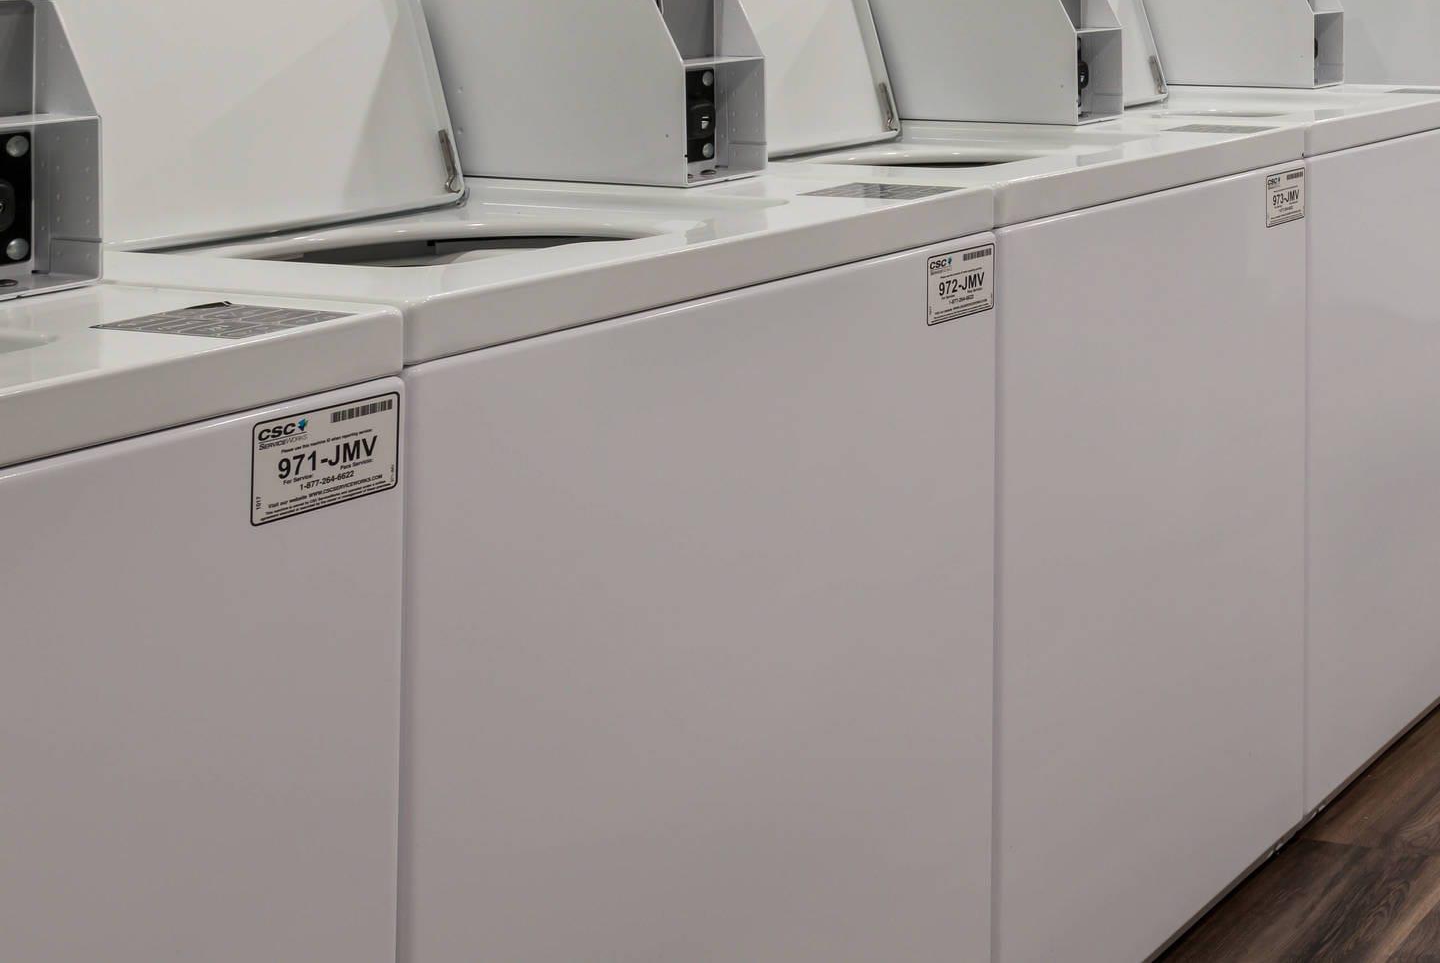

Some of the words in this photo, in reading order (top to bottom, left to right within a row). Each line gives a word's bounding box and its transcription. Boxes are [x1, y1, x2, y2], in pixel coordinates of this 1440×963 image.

[1272, 189, 1299, 205] 973-JMV
[930, 259, 947, 269] CSC
[939, 272, 985, 296] 972-JMV
[258, 422, 296, 441] CSC
[277, 435, 378, 480] 971-JMV
[300, 470, 355, 491] 1-877-264-6622
